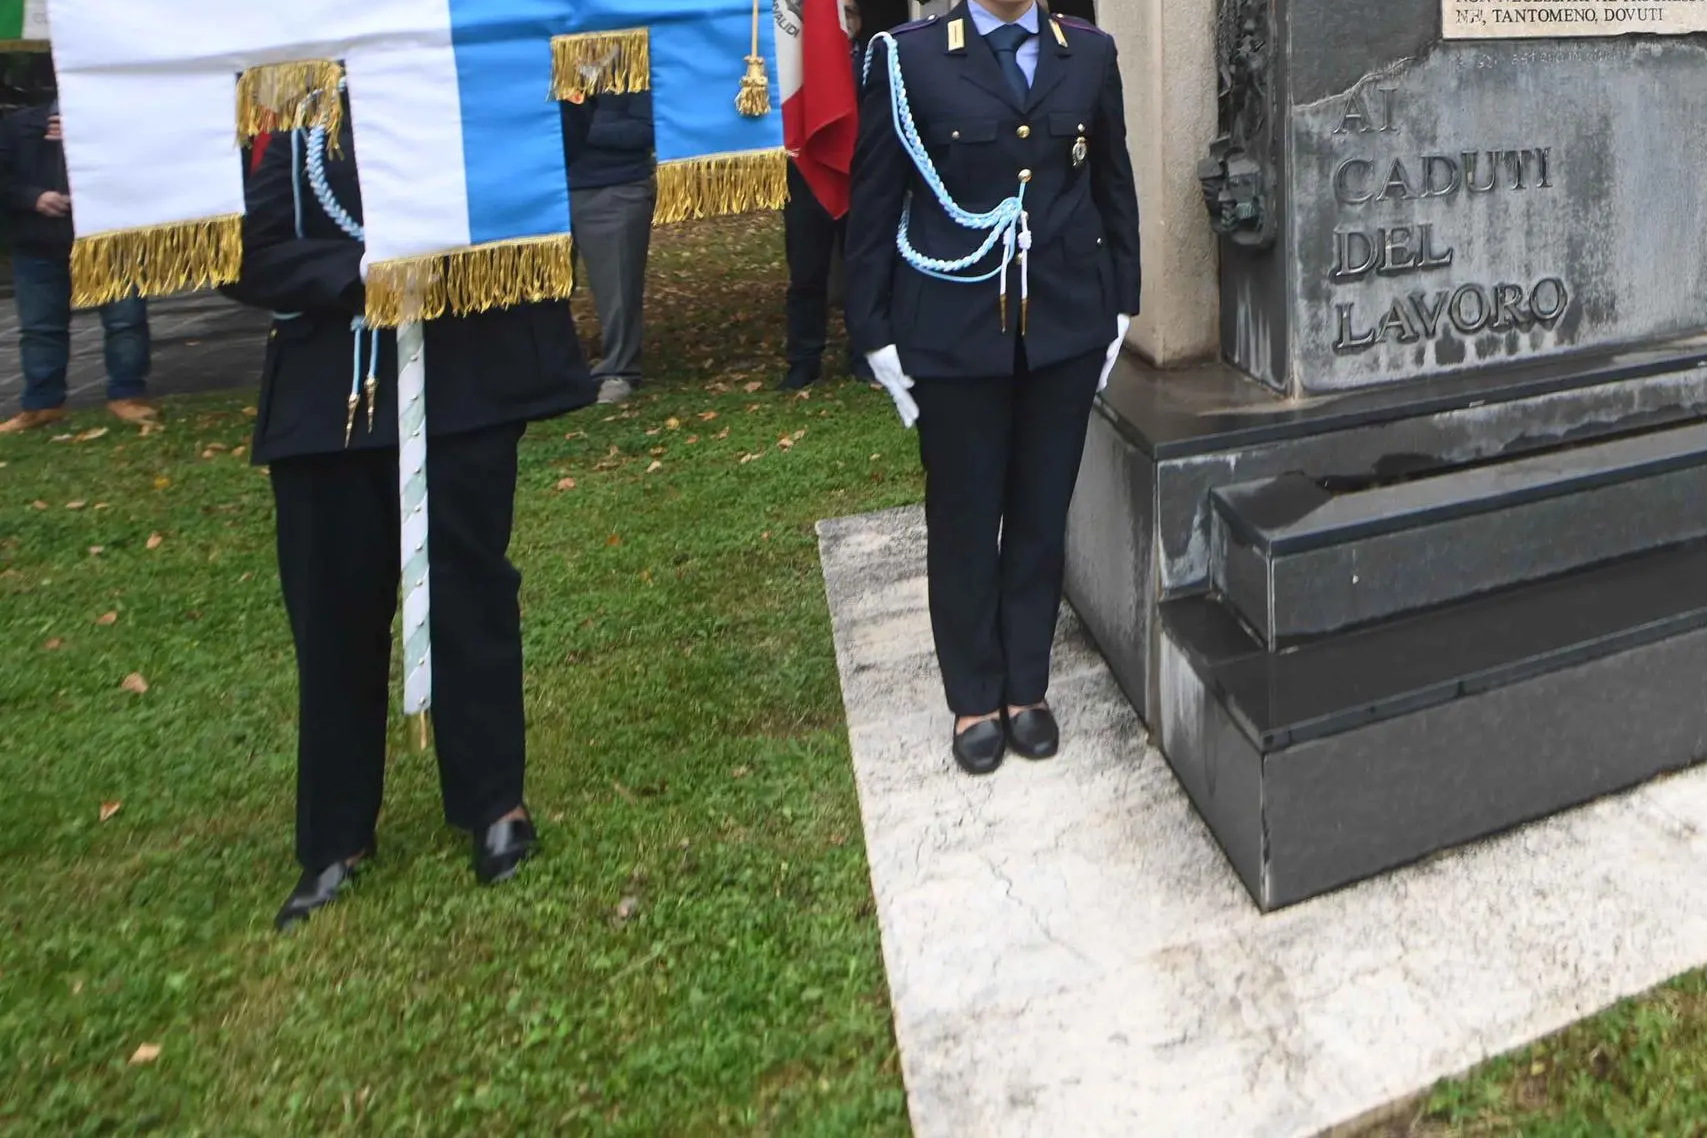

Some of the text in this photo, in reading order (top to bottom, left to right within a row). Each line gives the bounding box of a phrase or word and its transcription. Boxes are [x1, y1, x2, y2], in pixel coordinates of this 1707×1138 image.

[1492, 8, 1598, 25] TANTOMENO,
[1604, 8, 1664, 22] DOVUTI
[1332, 86, 1399, 134] AI
[1333, 146, 1553, 205] CADUTI
[1333, 223, 1453, 278] DEL
[1334, 277, 1568, 349] LAVORO
